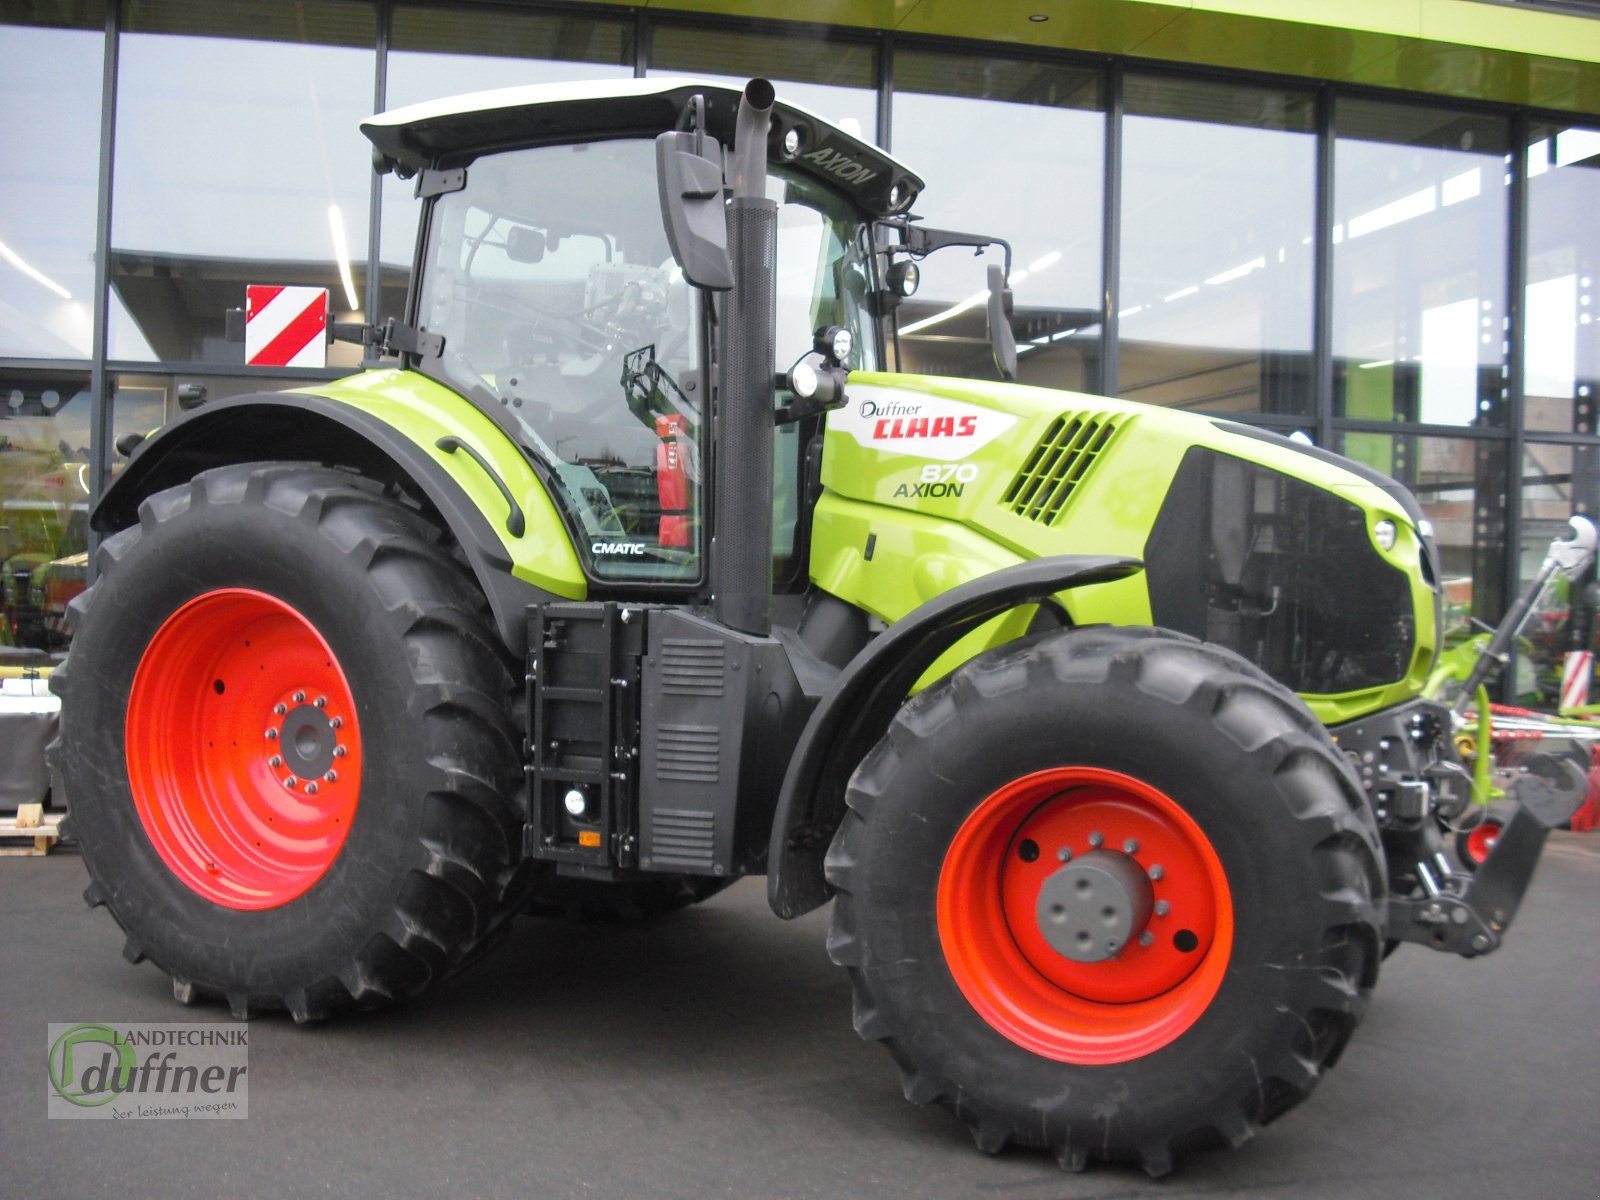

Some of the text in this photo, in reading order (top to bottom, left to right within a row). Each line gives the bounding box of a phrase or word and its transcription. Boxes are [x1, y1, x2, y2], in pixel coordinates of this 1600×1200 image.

[802, 147, 878, 185] AXION
[859, 400, 923, 419] Duffner
[872, 415, 978, 440] CLAAS
[667, 421, 678, 470] CLAS
[919, 463, 979, 483] 870
[892, 482, 965, 498] AXION
[591, 542, 646, 555] CMATIC
